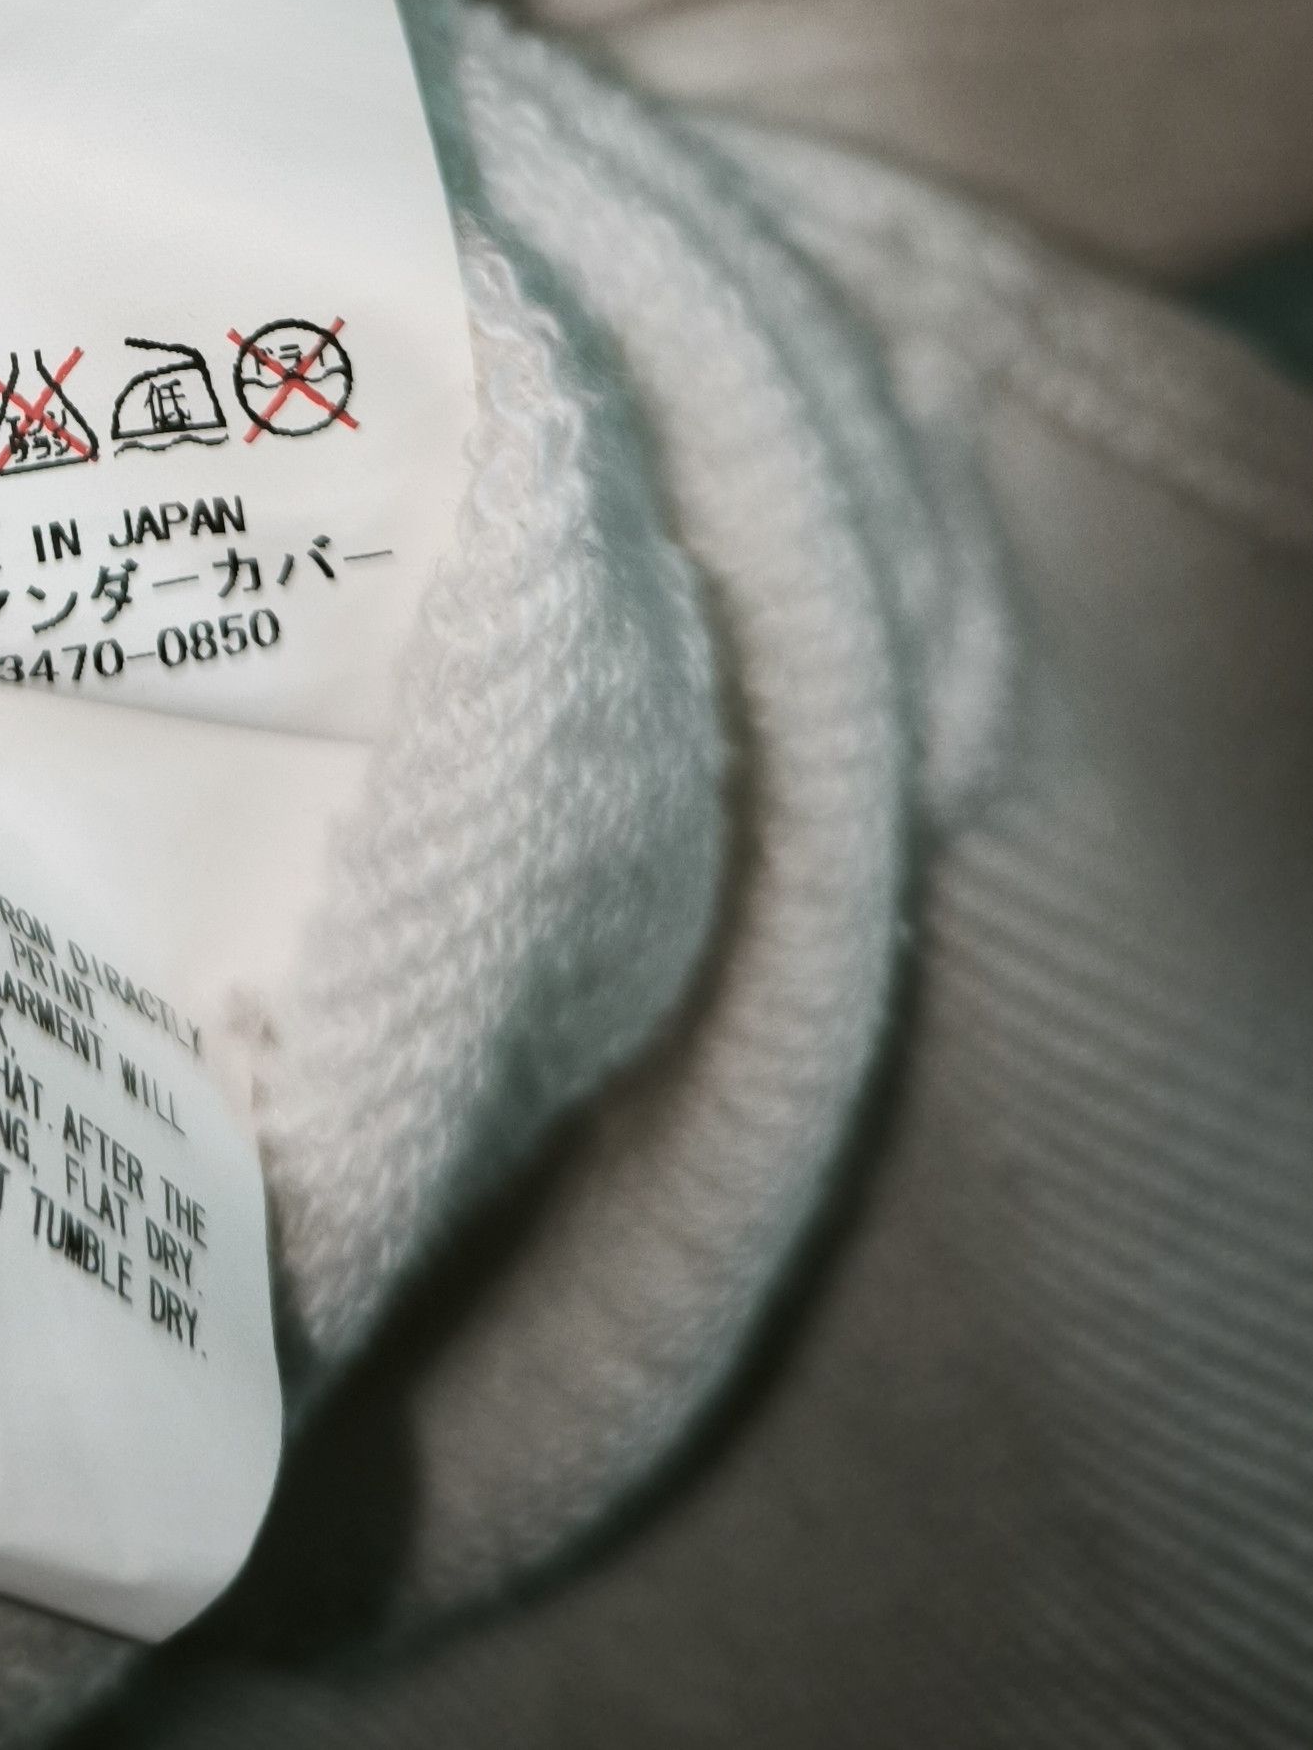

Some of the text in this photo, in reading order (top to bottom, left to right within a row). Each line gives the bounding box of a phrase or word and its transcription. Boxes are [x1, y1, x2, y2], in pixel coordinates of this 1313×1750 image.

[32, 518, 81, 562] IN
[108, 495, 245, 548] JAPAN
[119, 1052, 186, 1136] WILL
[63, 1103, 145, 1200] AFTER
[160, 1175, 208, 1250] THE
[65, 1153, 129, 1239] FLAT
[145, 1216, 203, 1297] DRY.
[30, 1185, 133, 1305] TUMBLE
[149, 1274, 208, 1360] DRY.
